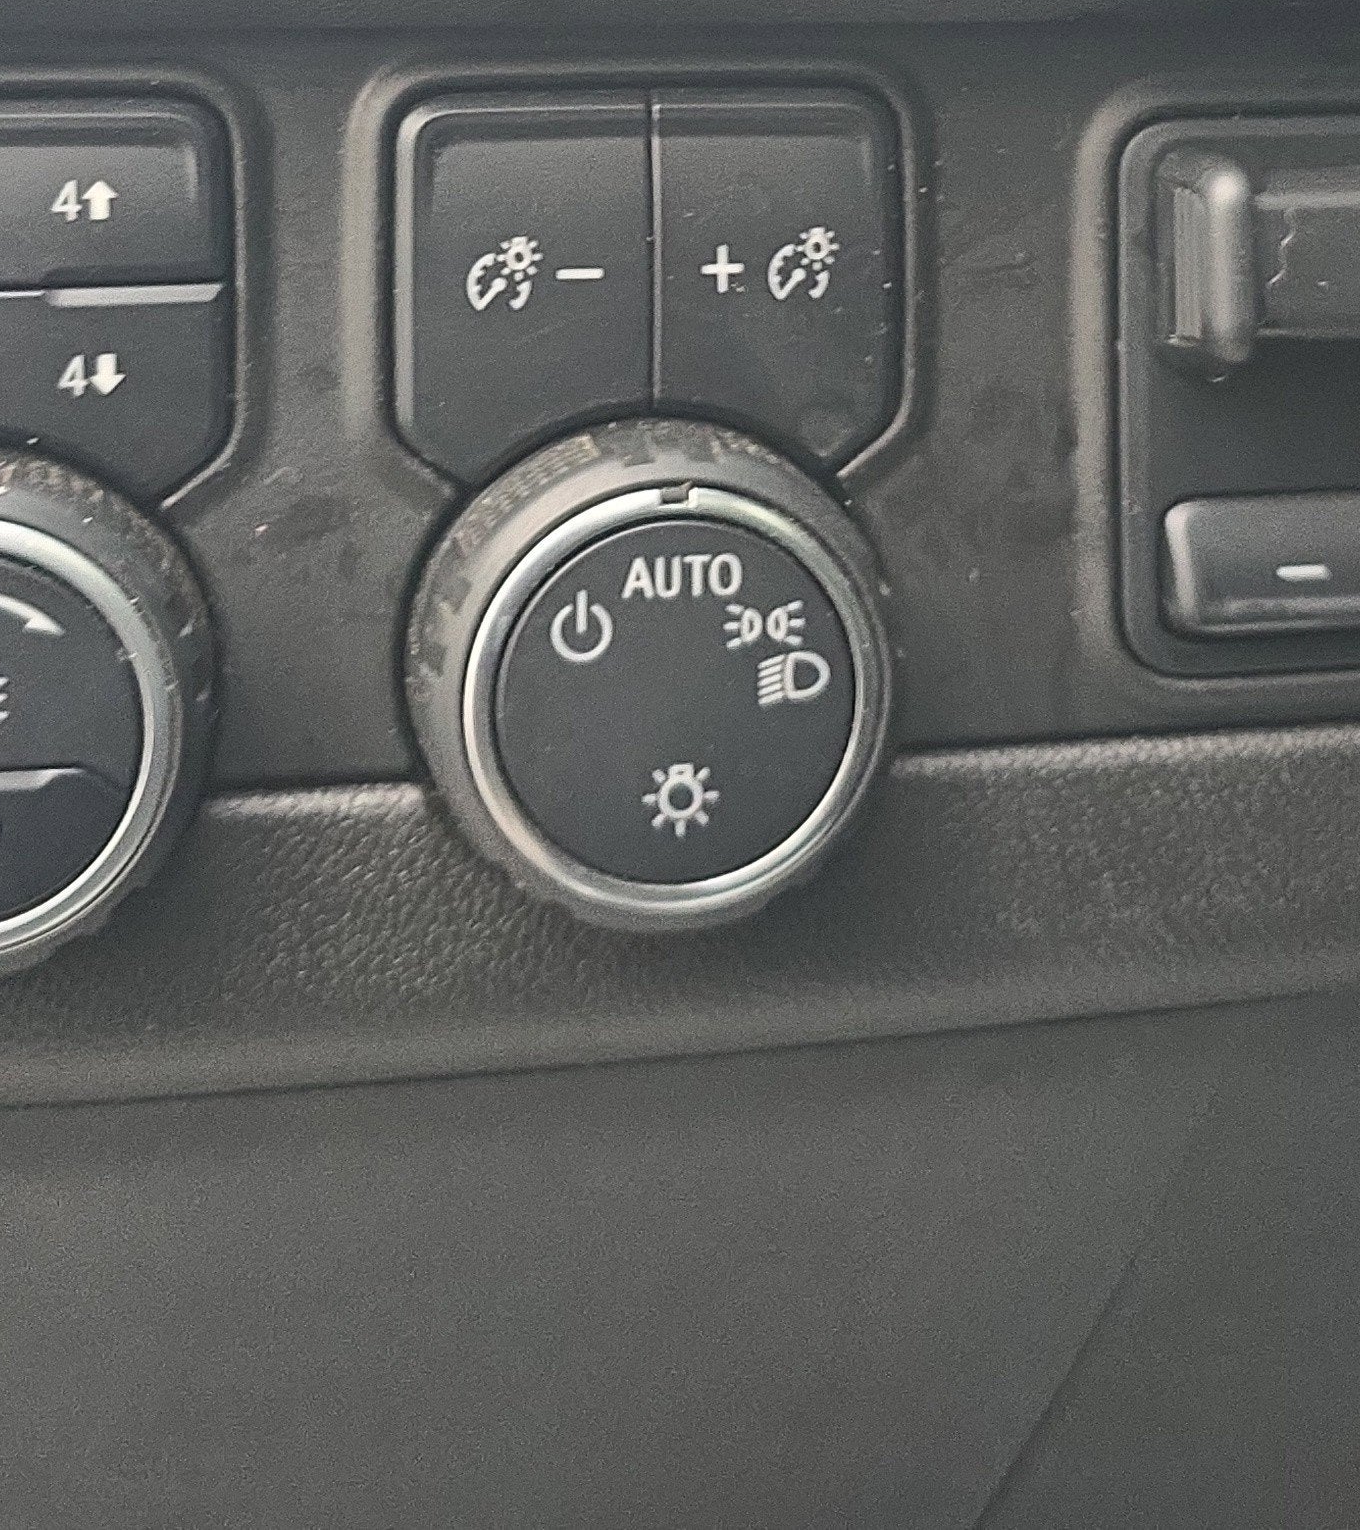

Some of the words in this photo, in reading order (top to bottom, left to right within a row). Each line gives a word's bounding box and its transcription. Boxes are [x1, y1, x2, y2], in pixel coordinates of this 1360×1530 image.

[50, 179, 83, 222] 4
[56, 354, 89, 398] 4
[621, 552, 743, 600] AUTO
